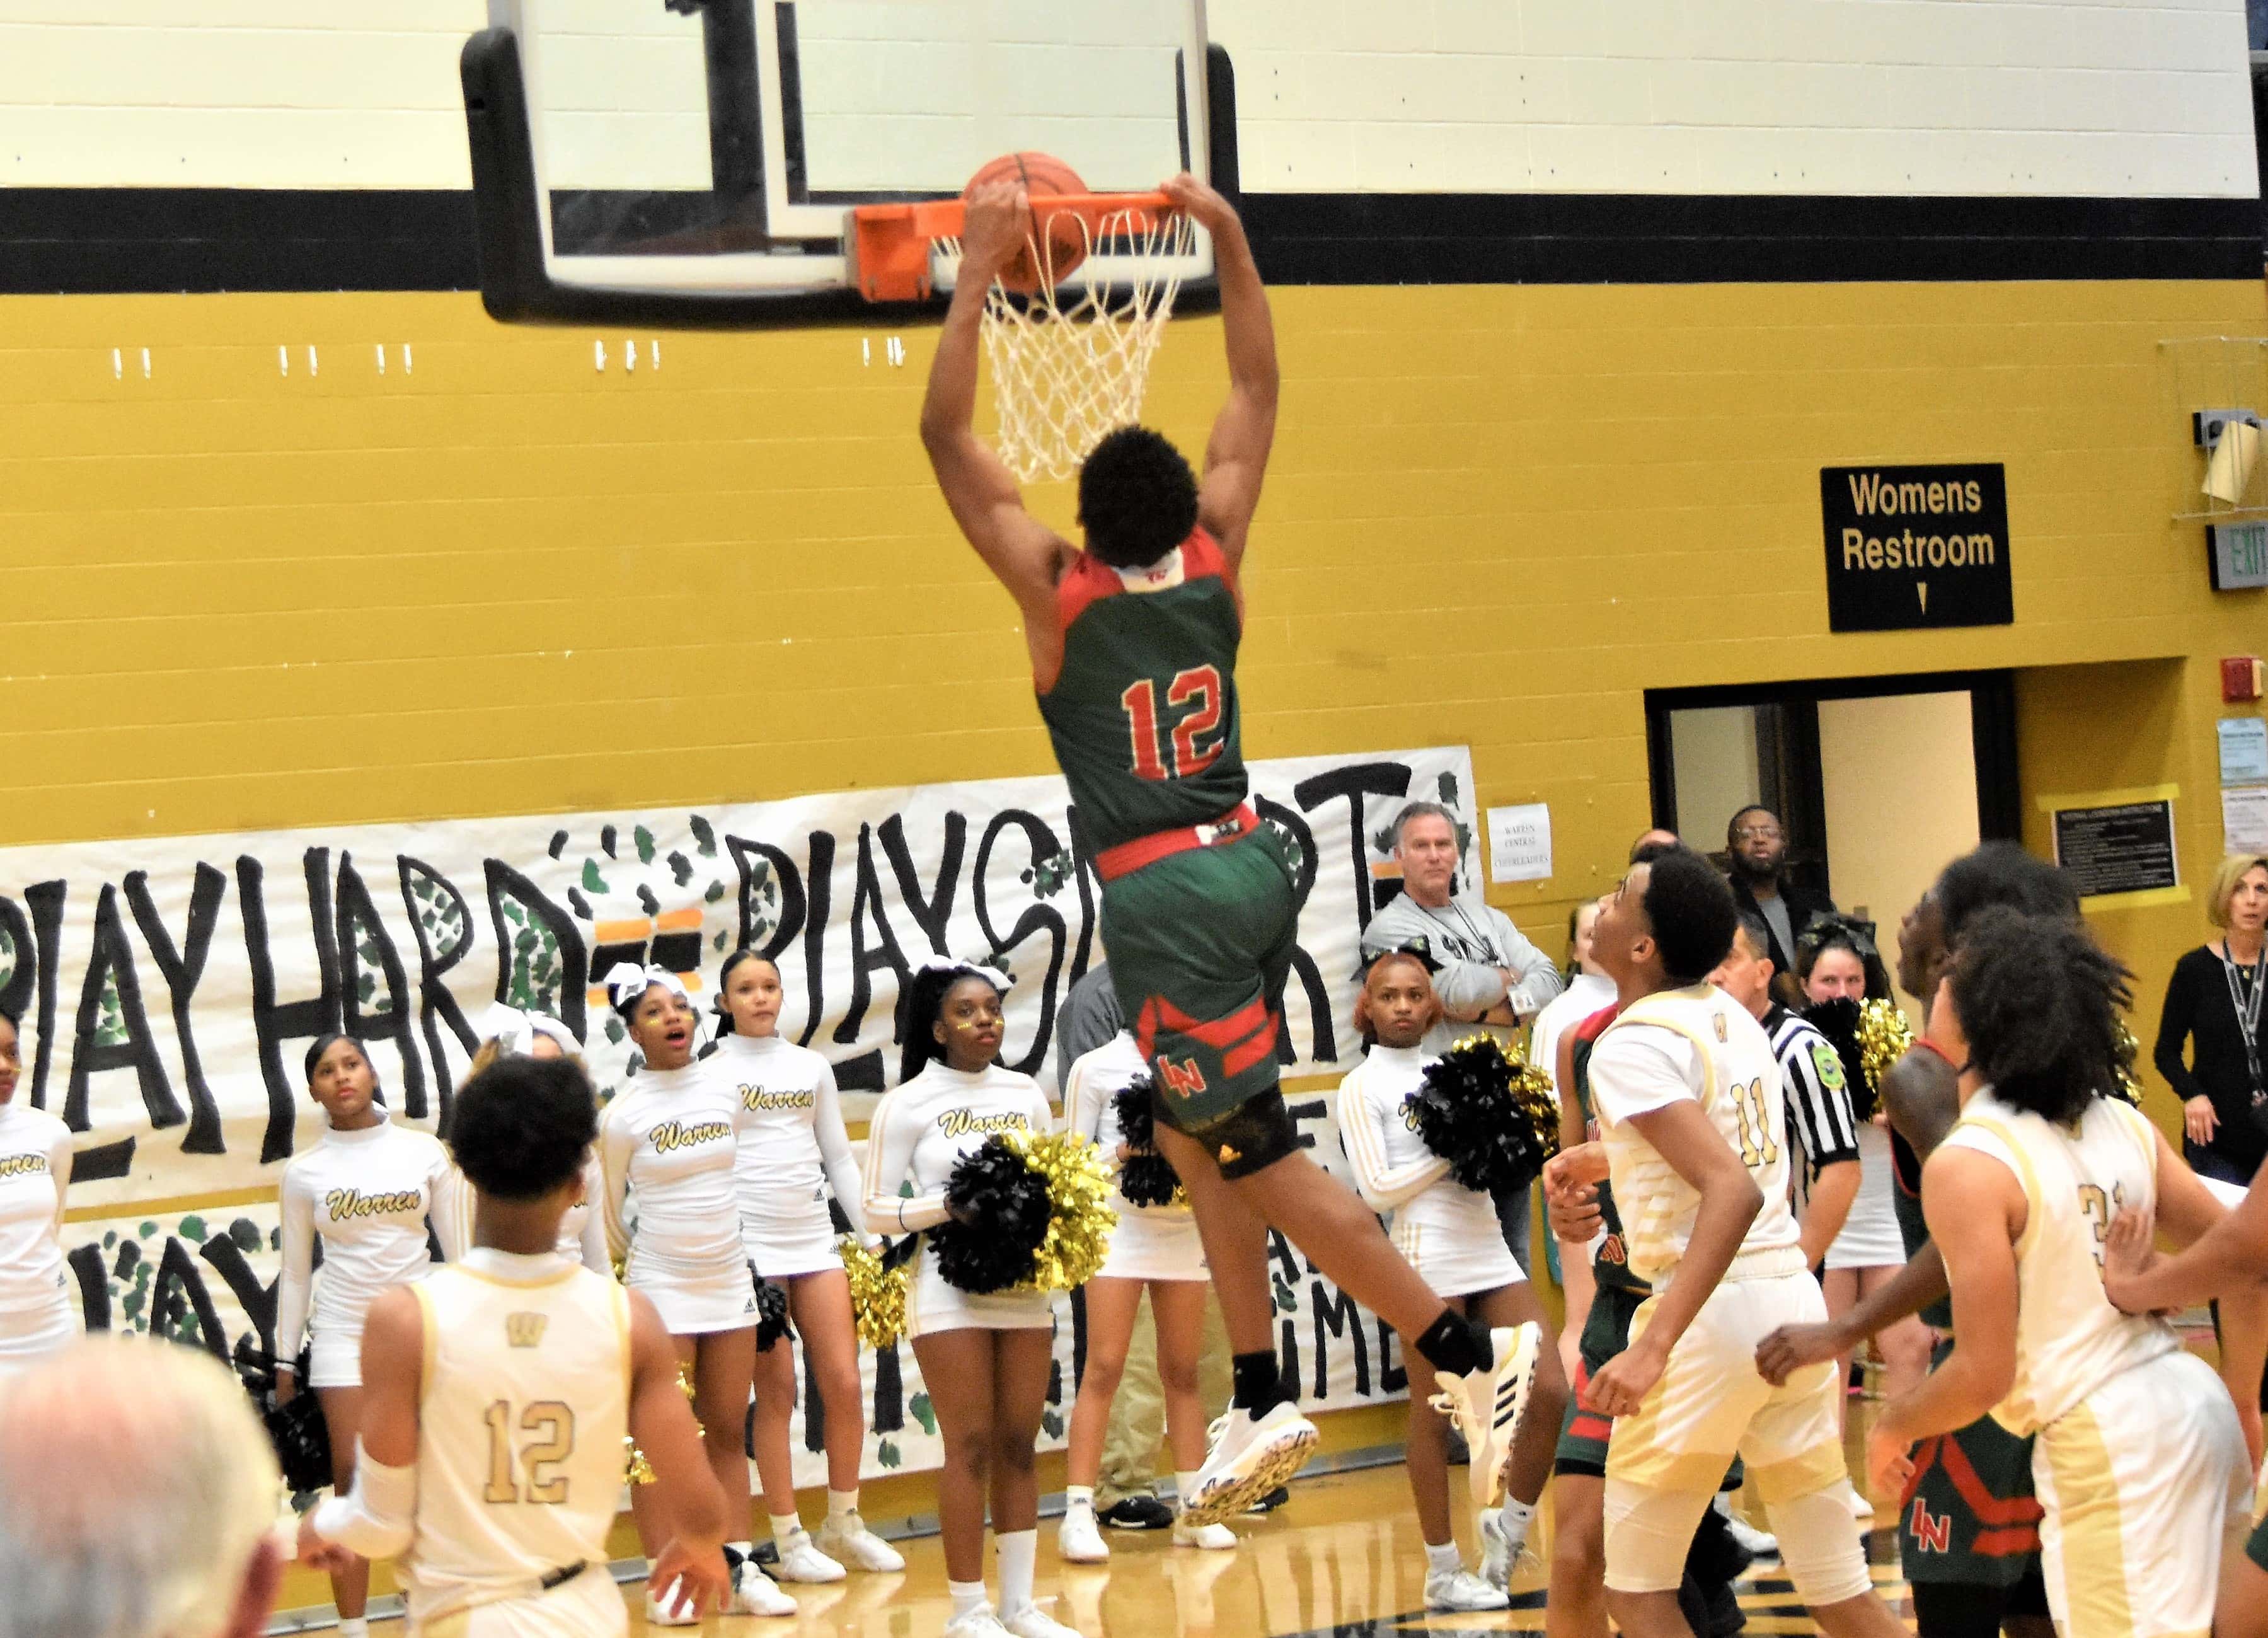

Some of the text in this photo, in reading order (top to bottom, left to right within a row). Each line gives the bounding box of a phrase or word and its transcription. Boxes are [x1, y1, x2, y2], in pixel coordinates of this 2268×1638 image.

[1848, 473, 1983, 515] Womens
[1842, 528, 1995, 570] Restroom
[1121, 664, 1224, 780] 12
[738, 1083, 815, 1111] Warren
[650, 1121, 731, 1154] Warren
[938, 1109, 1028, 1139] Warren
[1730, 1077, 1777, 1167] 11
[326, 1188, 422, 1221] Warren
[483, 1397, 575, 1504] 12
